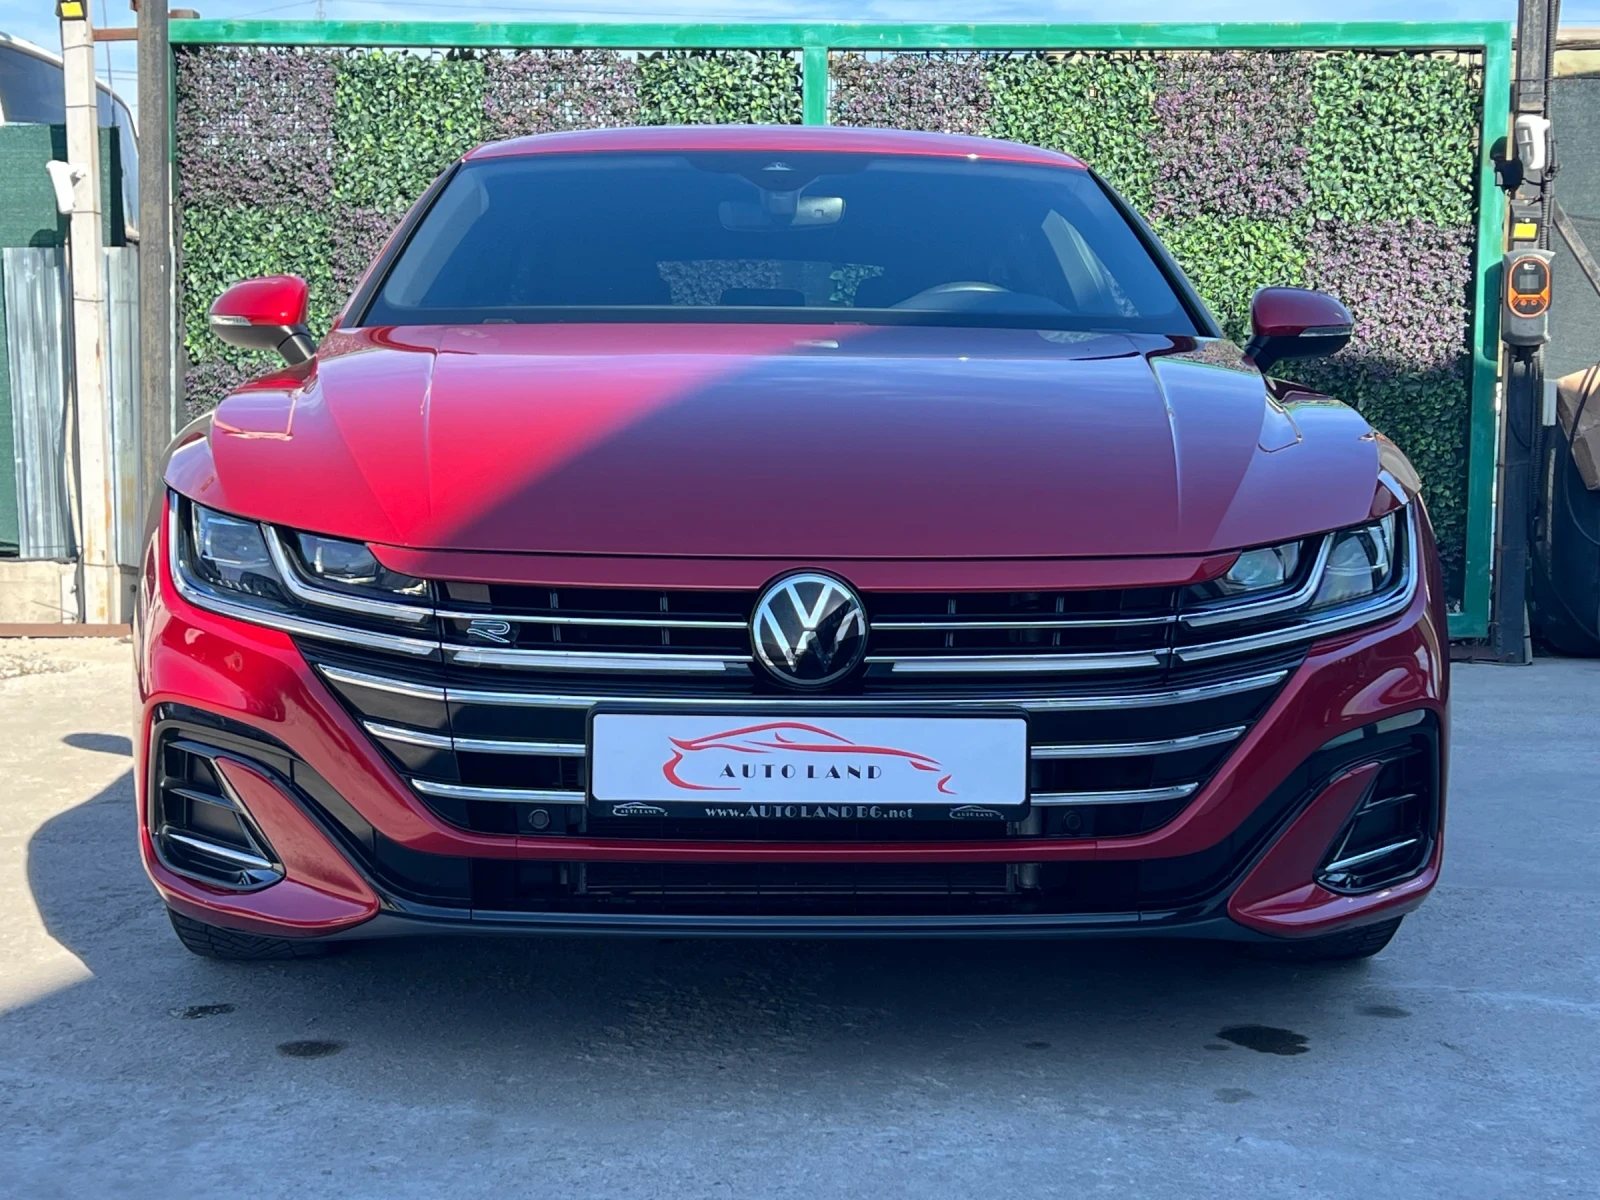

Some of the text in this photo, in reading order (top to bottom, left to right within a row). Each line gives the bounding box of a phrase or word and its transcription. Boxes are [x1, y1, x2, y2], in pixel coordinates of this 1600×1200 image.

[759, 580, 861, 673] VW
[719, 763, 882, 779] AUTO LAND
